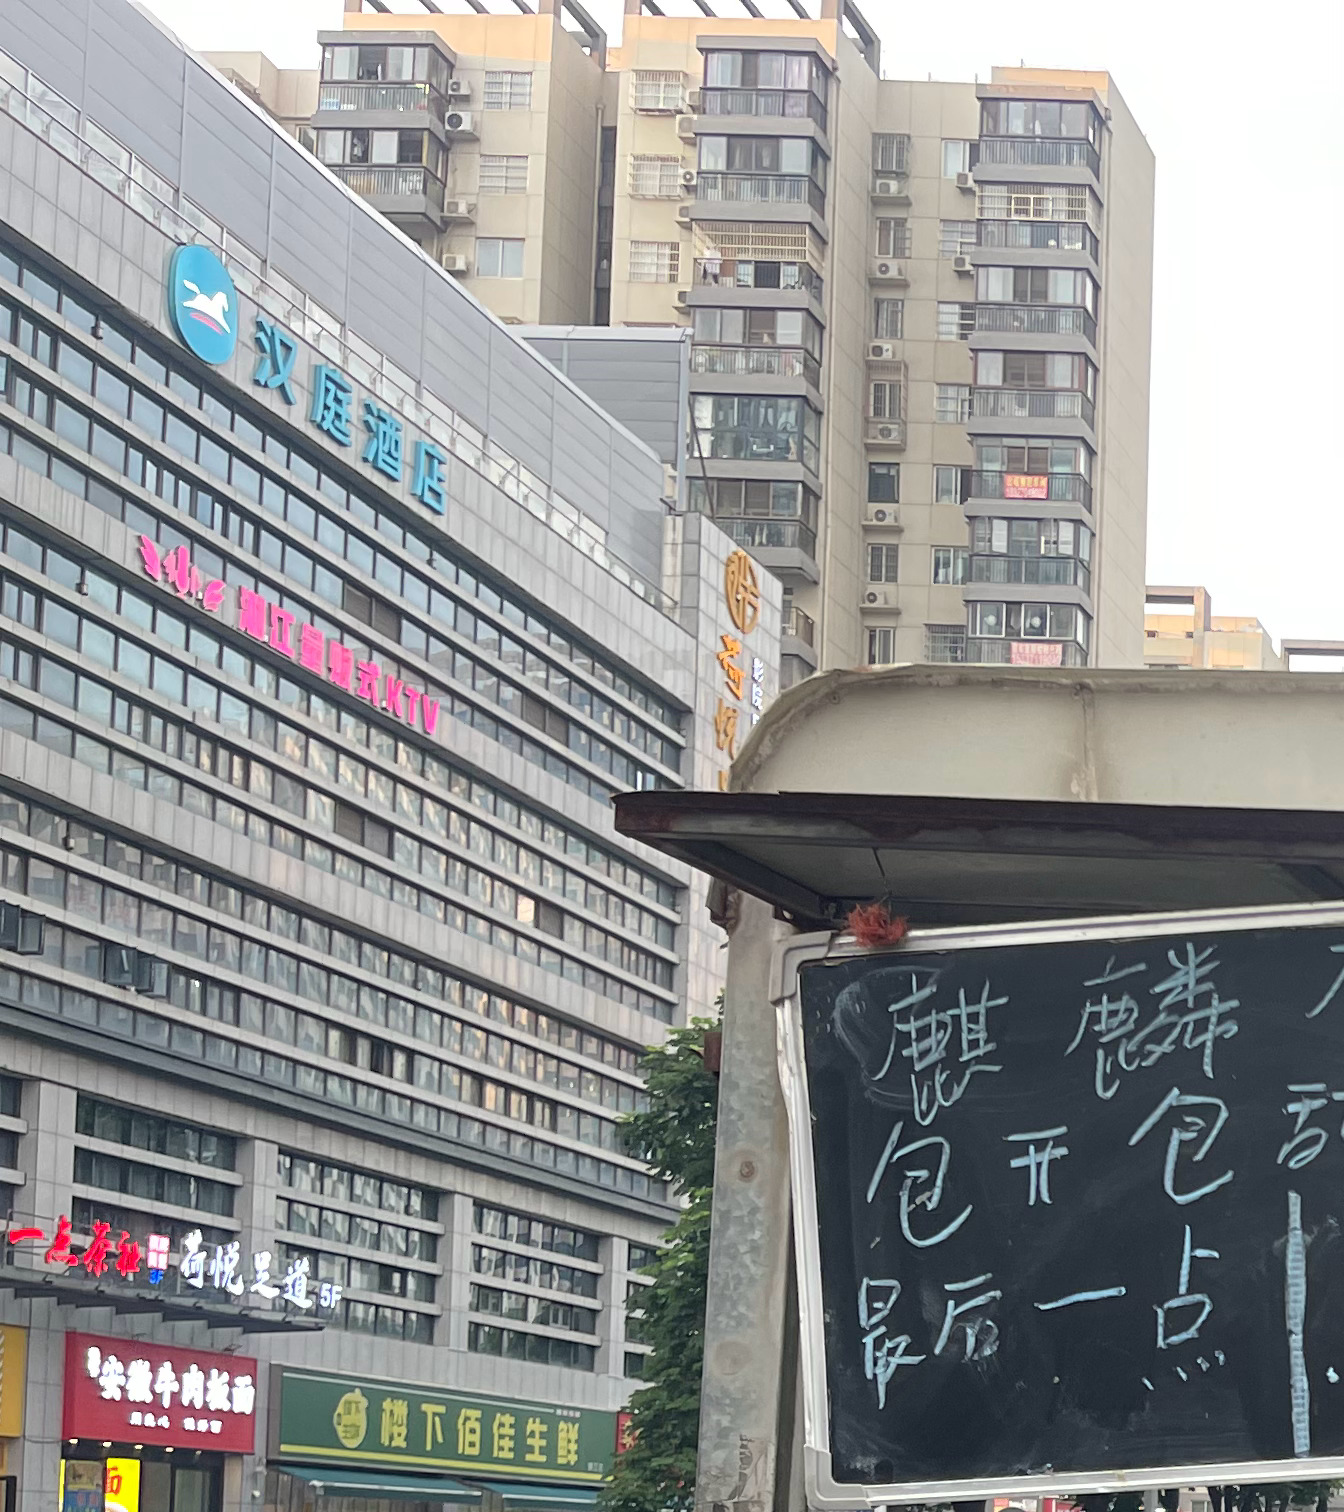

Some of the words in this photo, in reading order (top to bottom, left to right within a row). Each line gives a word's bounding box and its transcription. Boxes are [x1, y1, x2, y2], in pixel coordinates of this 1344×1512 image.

[253, 316, 448, 516] 汉庭酒店
[319, 1283, 343, 1309] 5F
[380, 1396, 580, 1467] 楼下佰佳生鲜
